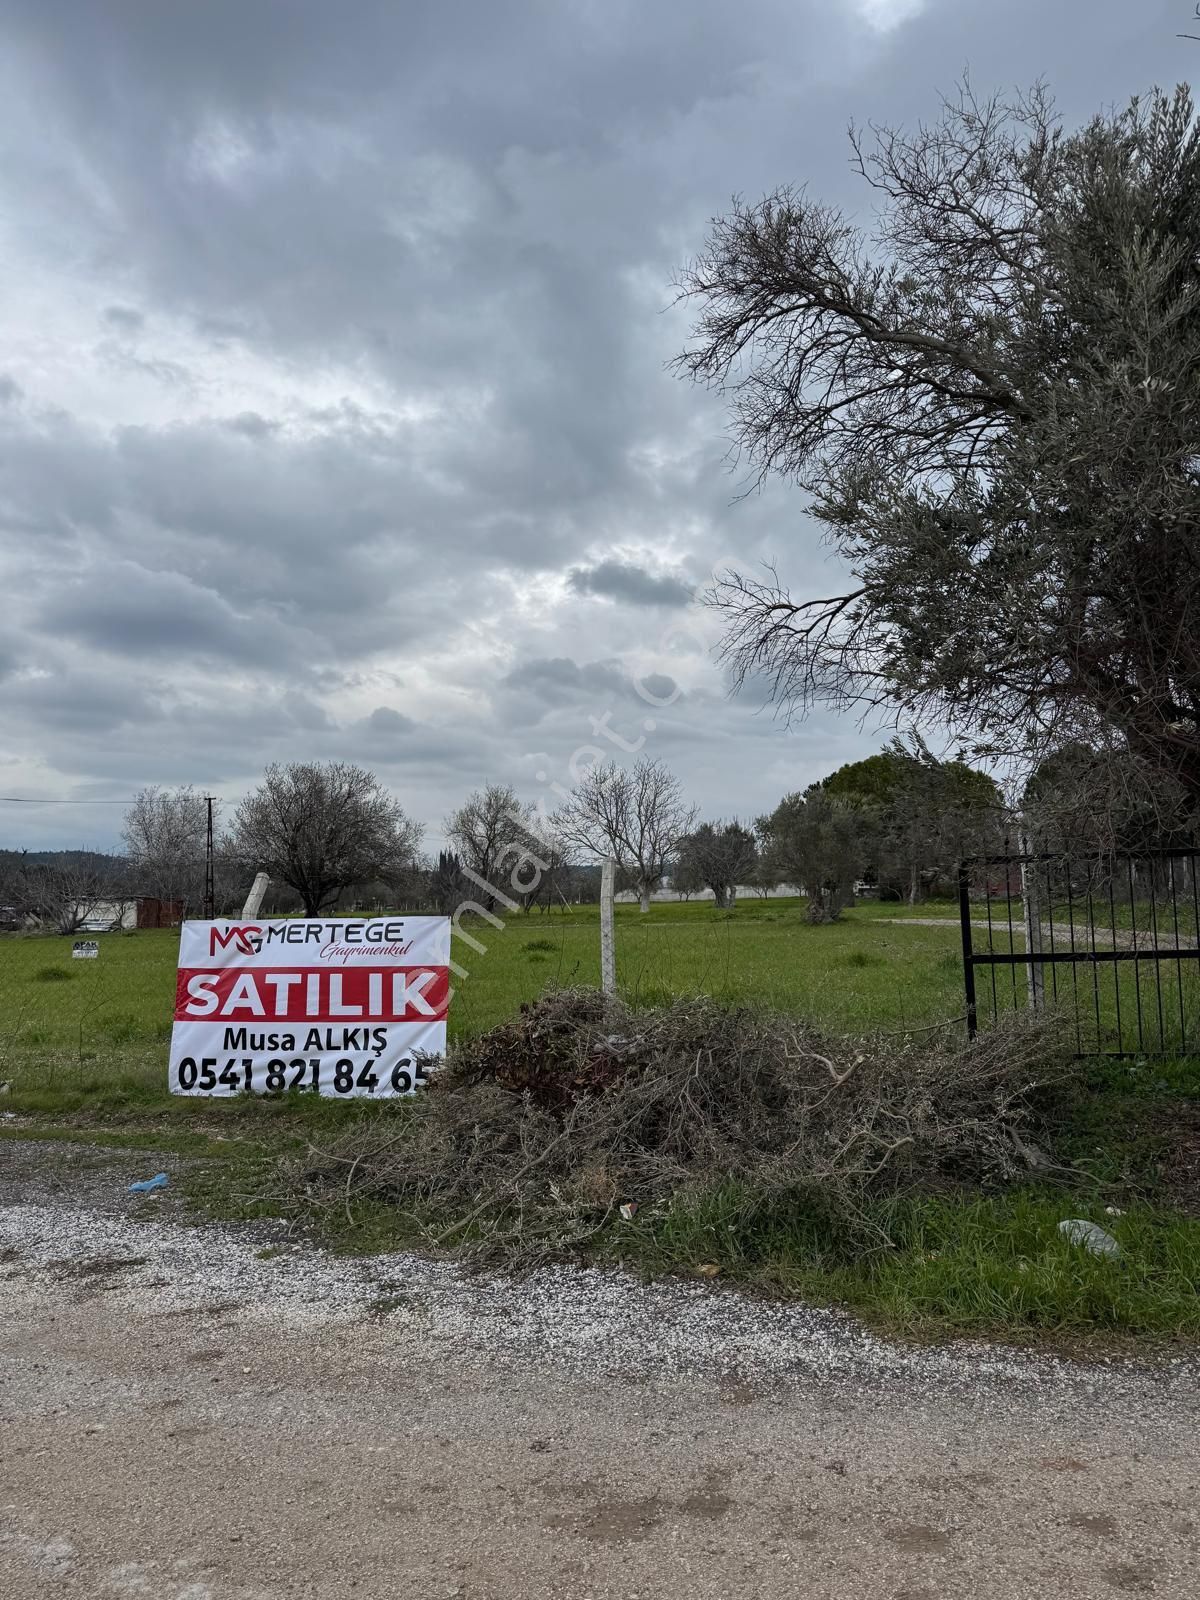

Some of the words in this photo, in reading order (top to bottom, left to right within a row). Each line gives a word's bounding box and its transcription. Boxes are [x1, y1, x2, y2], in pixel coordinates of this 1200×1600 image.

[267, 922, 404, 944] MERTEGE
[320, 939, 414, 964] Gayrimenkul
[185, 972, 437, 1016] SATILIK
[224, 1028, 295, 1052] Musa
[304, 1028, 388, 1058] ALKIŞ
[178, 1057, 253, 1090] 0541
[265, 1059, 320, 1092] 821
[334, 1058, 379, 1094] 84
